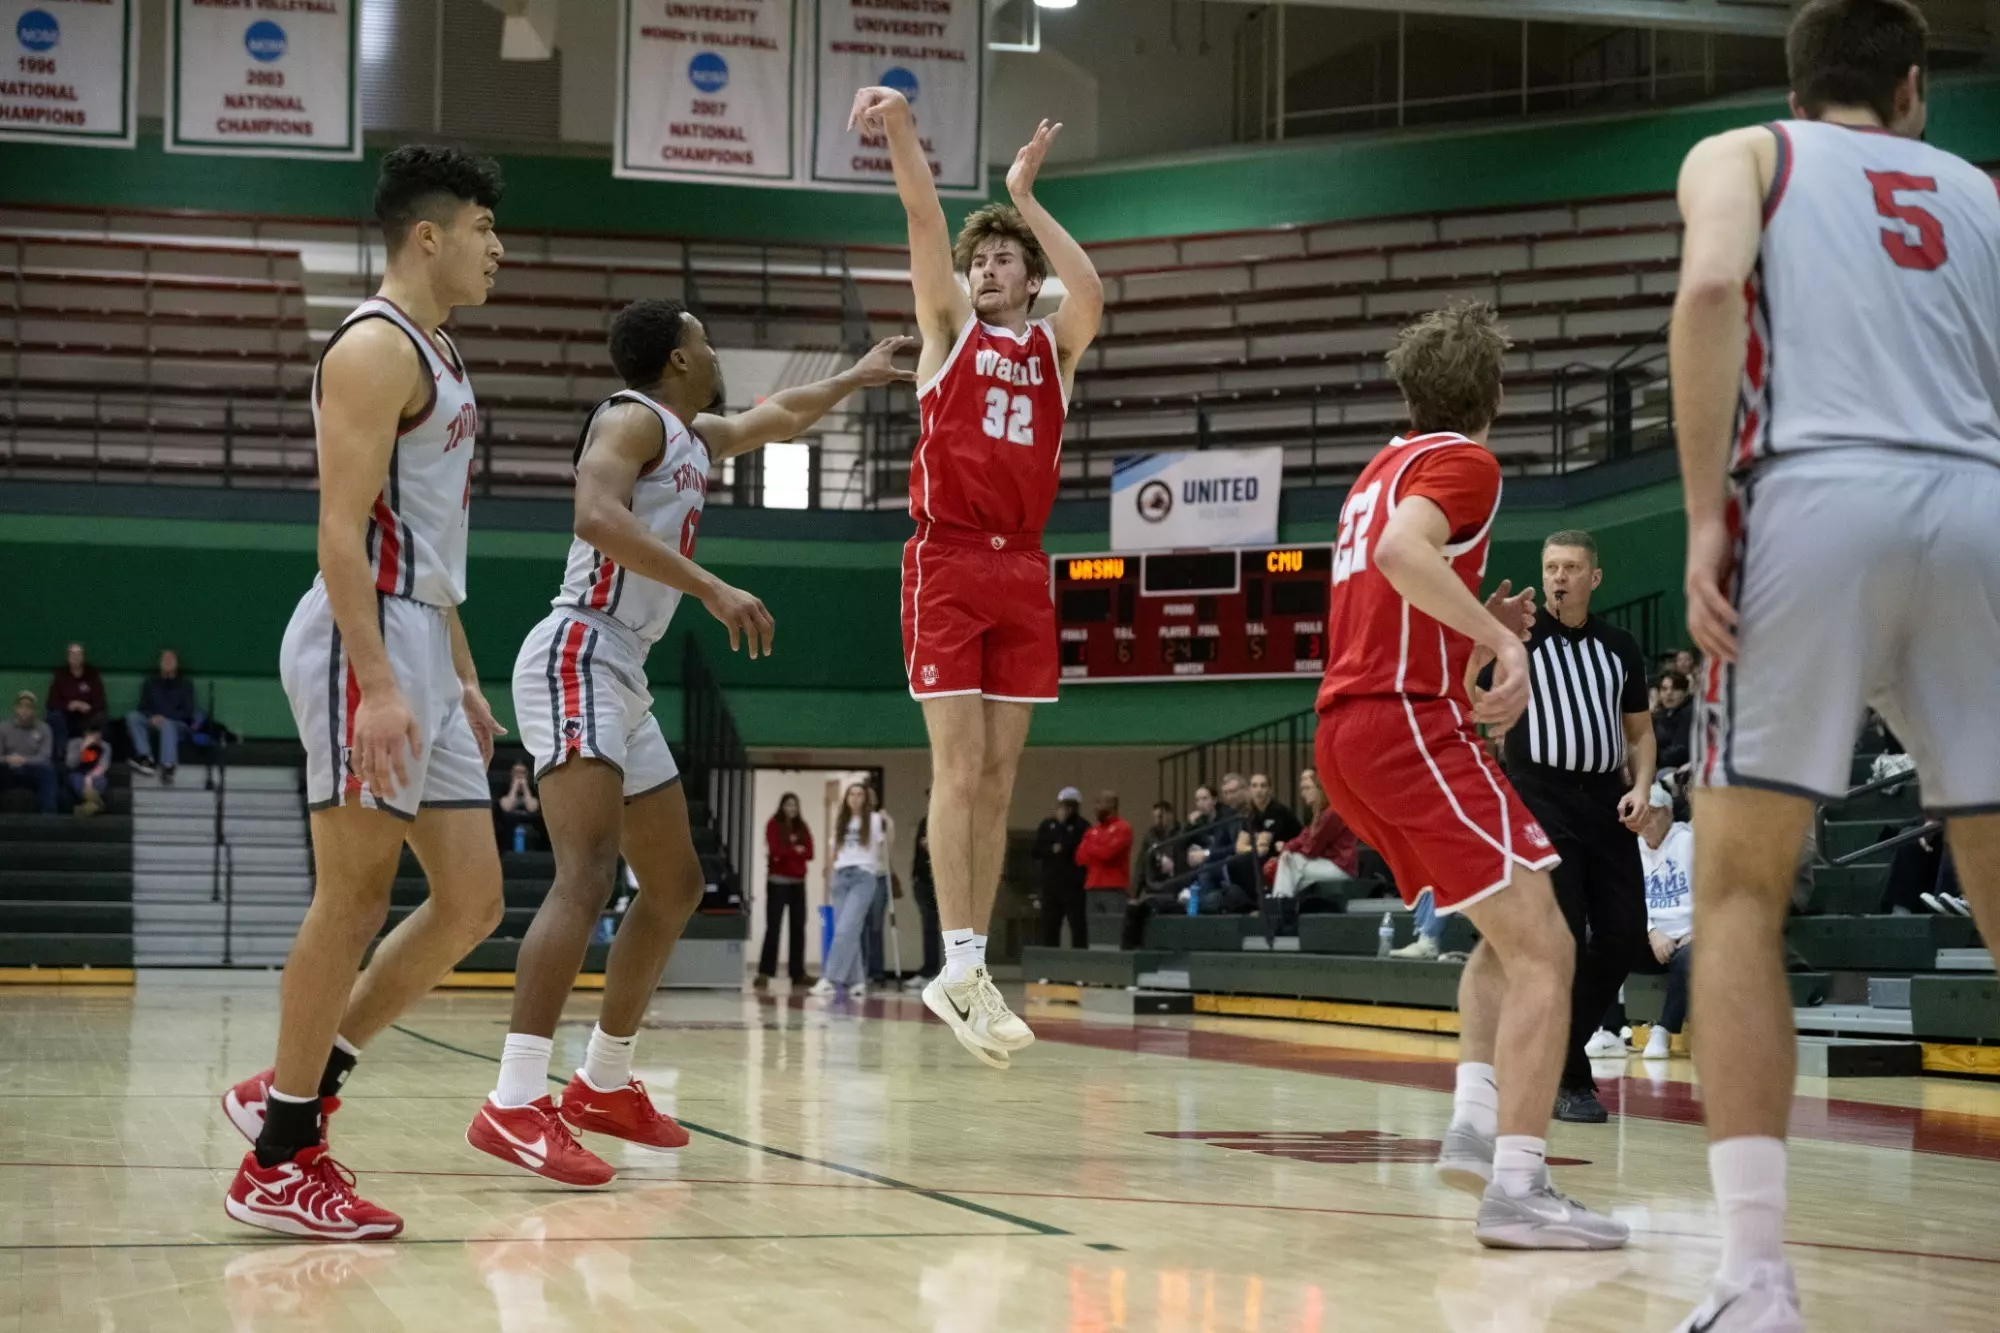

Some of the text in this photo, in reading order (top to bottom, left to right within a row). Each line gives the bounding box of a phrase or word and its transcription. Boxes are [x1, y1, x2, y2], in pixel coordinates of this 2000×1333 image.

[666, 4, 758, 22] UNIVERSITY
[854, 17, 946, 36] UNIVERSITY
[224, 93, 306, 112] NATIONAL
[0, 105, 86, 126] HAMPIONS
[216, 118, 314, 137] CHAMPIONS
[669, 123, 746, 142] NATIONAL
[661, 146, 754, 165] CHAMPIONS
[1864, 167, 1948, 271] 5
[982, 386, 1034, 447] 32
[1183, 477, 1259, 504] UNITED
[1069, 558, 1124, 580] WASHU
[1267, 550, 1302, 572] CMU
